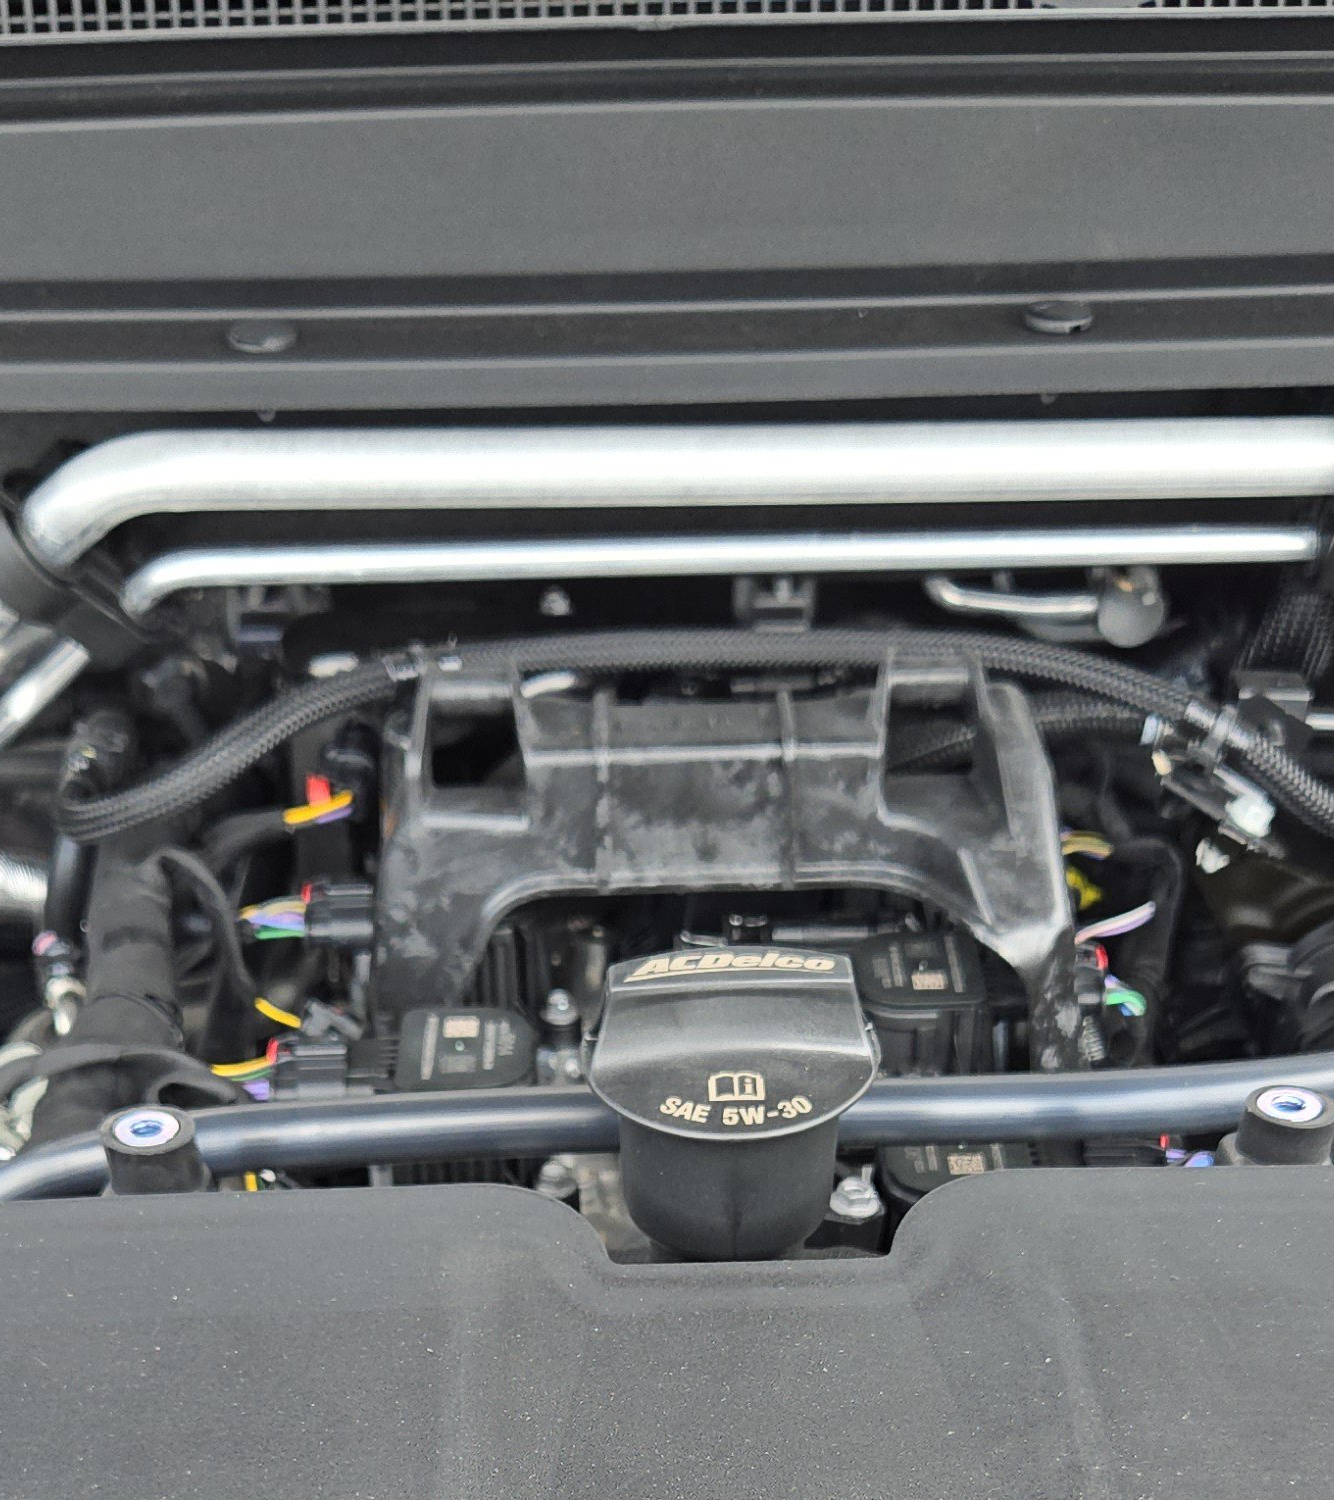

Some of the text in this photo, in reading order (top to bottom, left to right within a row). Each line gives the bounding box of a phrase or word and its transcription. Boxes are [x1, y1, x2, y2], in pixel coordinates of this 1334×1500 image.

[624, 953, 836, 982] ACDelco
[659, 1096, 812, 1126] SAE 5W-30
